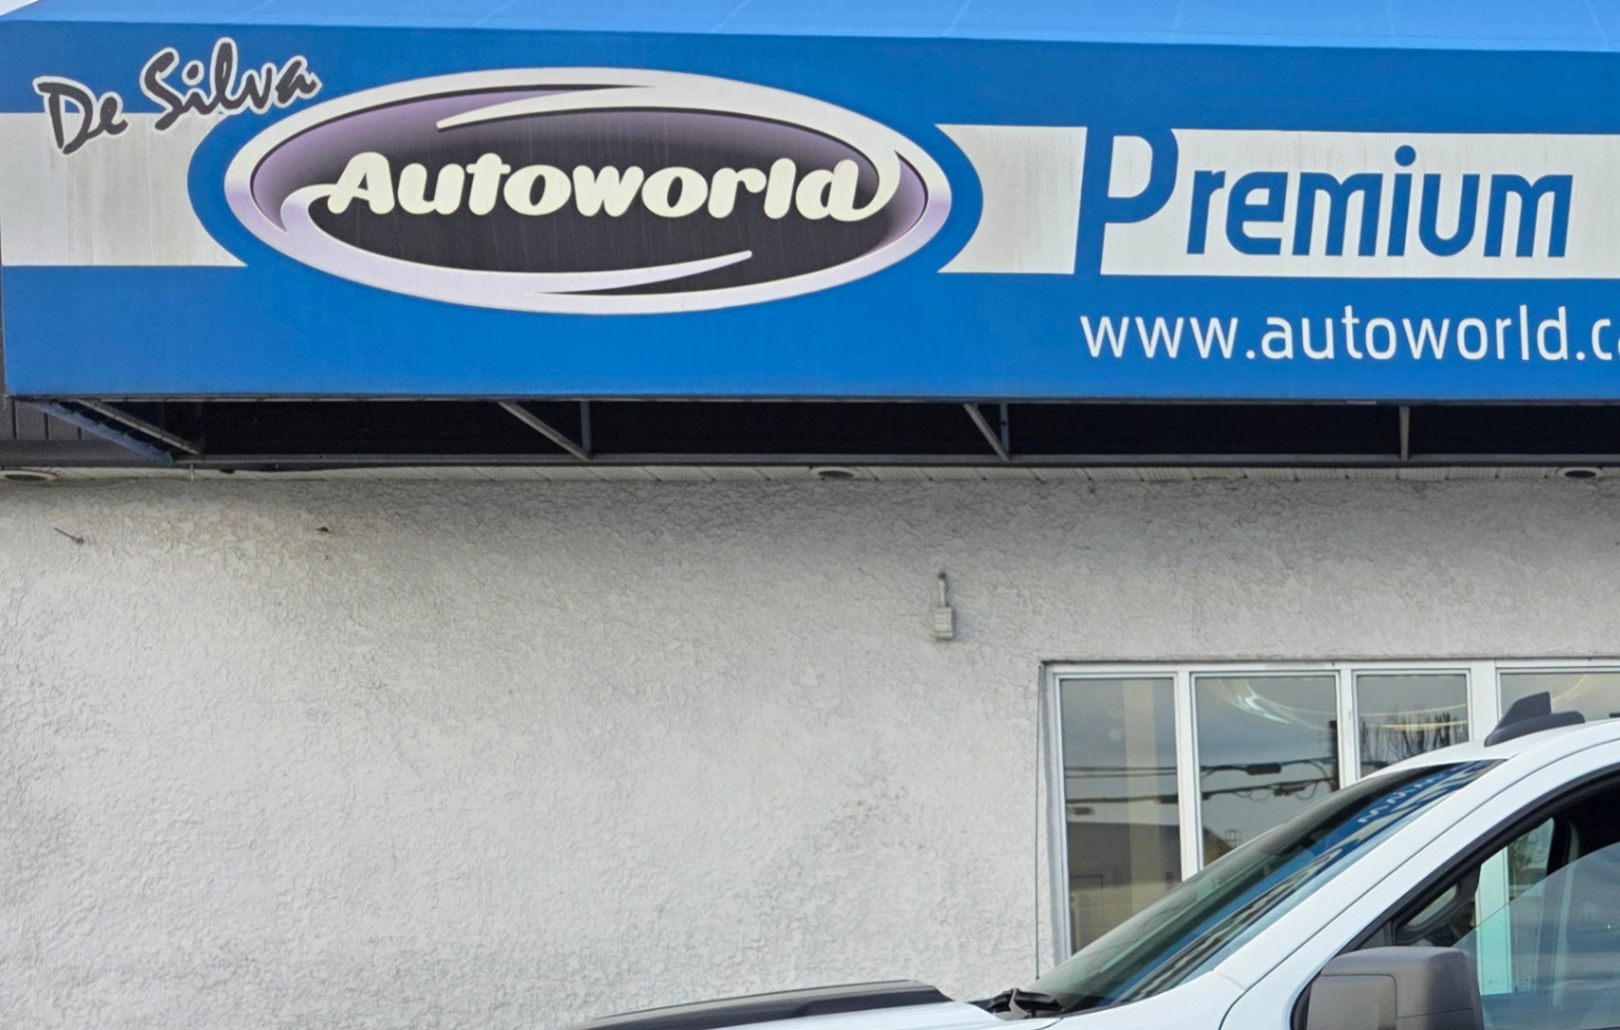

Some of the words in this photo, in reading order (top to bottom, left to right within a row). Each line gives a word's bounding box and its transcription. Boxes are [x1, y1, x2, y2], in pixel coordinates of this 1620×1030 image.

[36, 79, 129, 154] De
[143, 42, 318, 129] Silva
[326, 151, 872, 222] Autoworld
[1074, 128, 1574, 275] Premium
